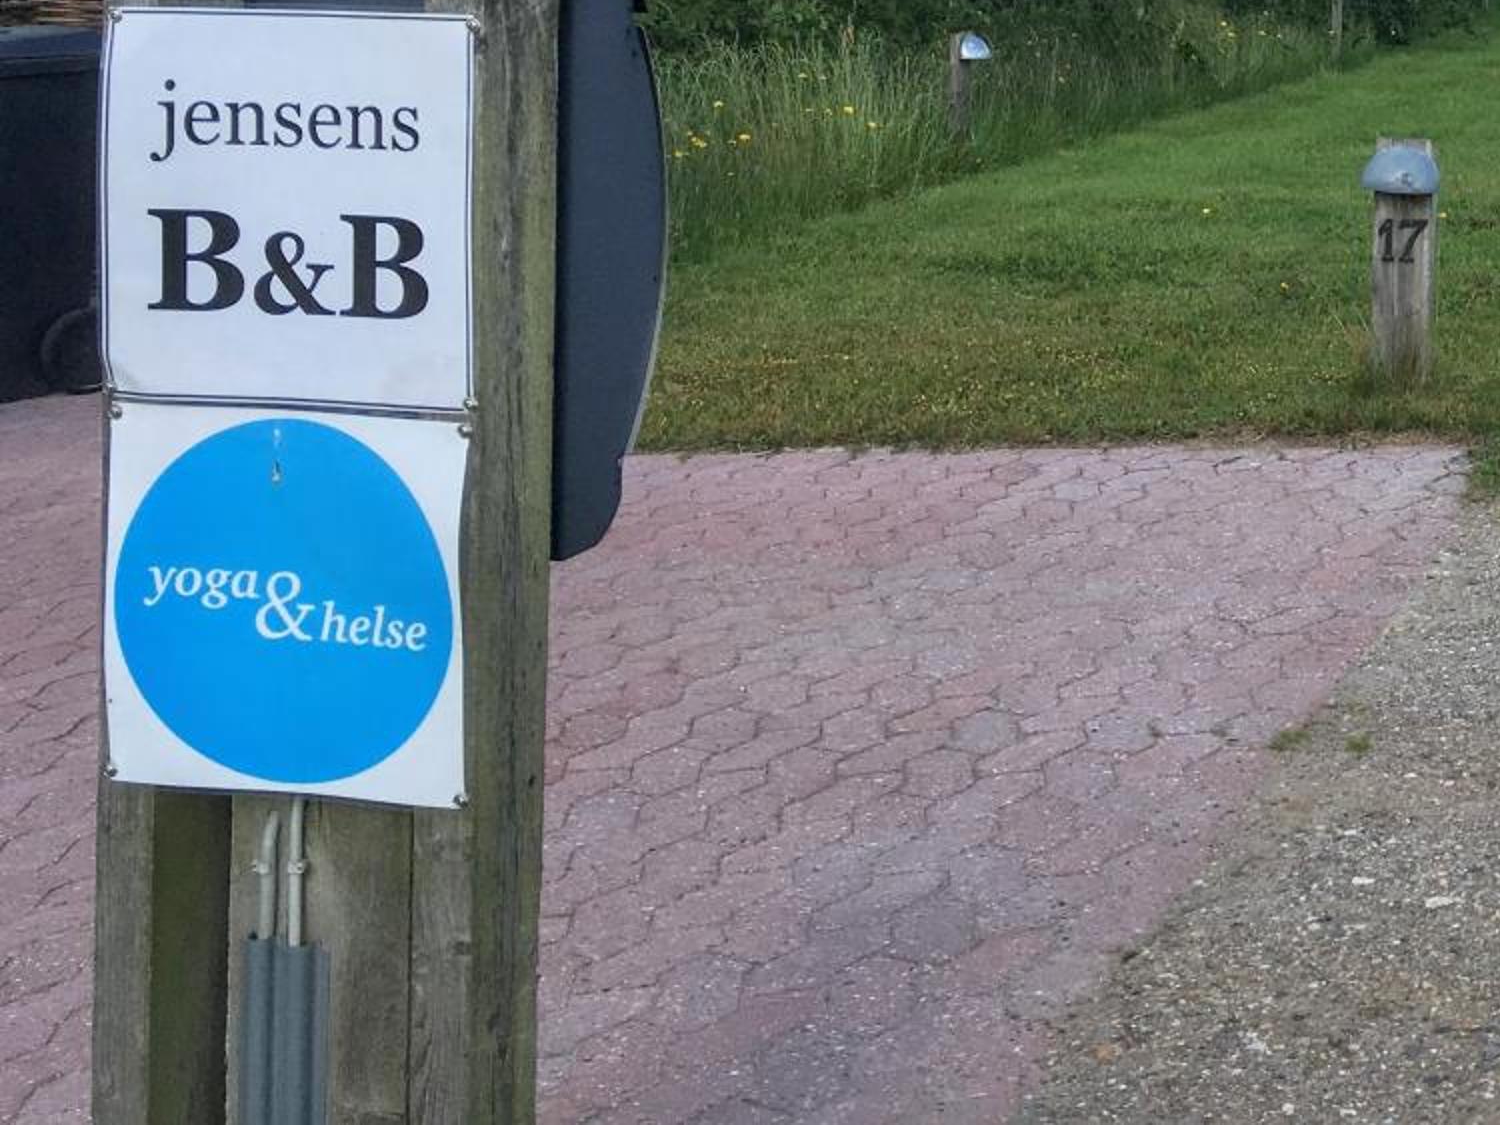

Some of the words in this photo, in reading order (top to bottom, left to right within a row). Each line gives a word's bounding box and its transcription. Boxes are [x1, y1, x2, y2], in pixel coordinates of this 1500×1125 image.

[150, 79, 420, 162] jensens
[147, 209, 430, 319] B&B
[1378, 219, 1428, 263] 17
